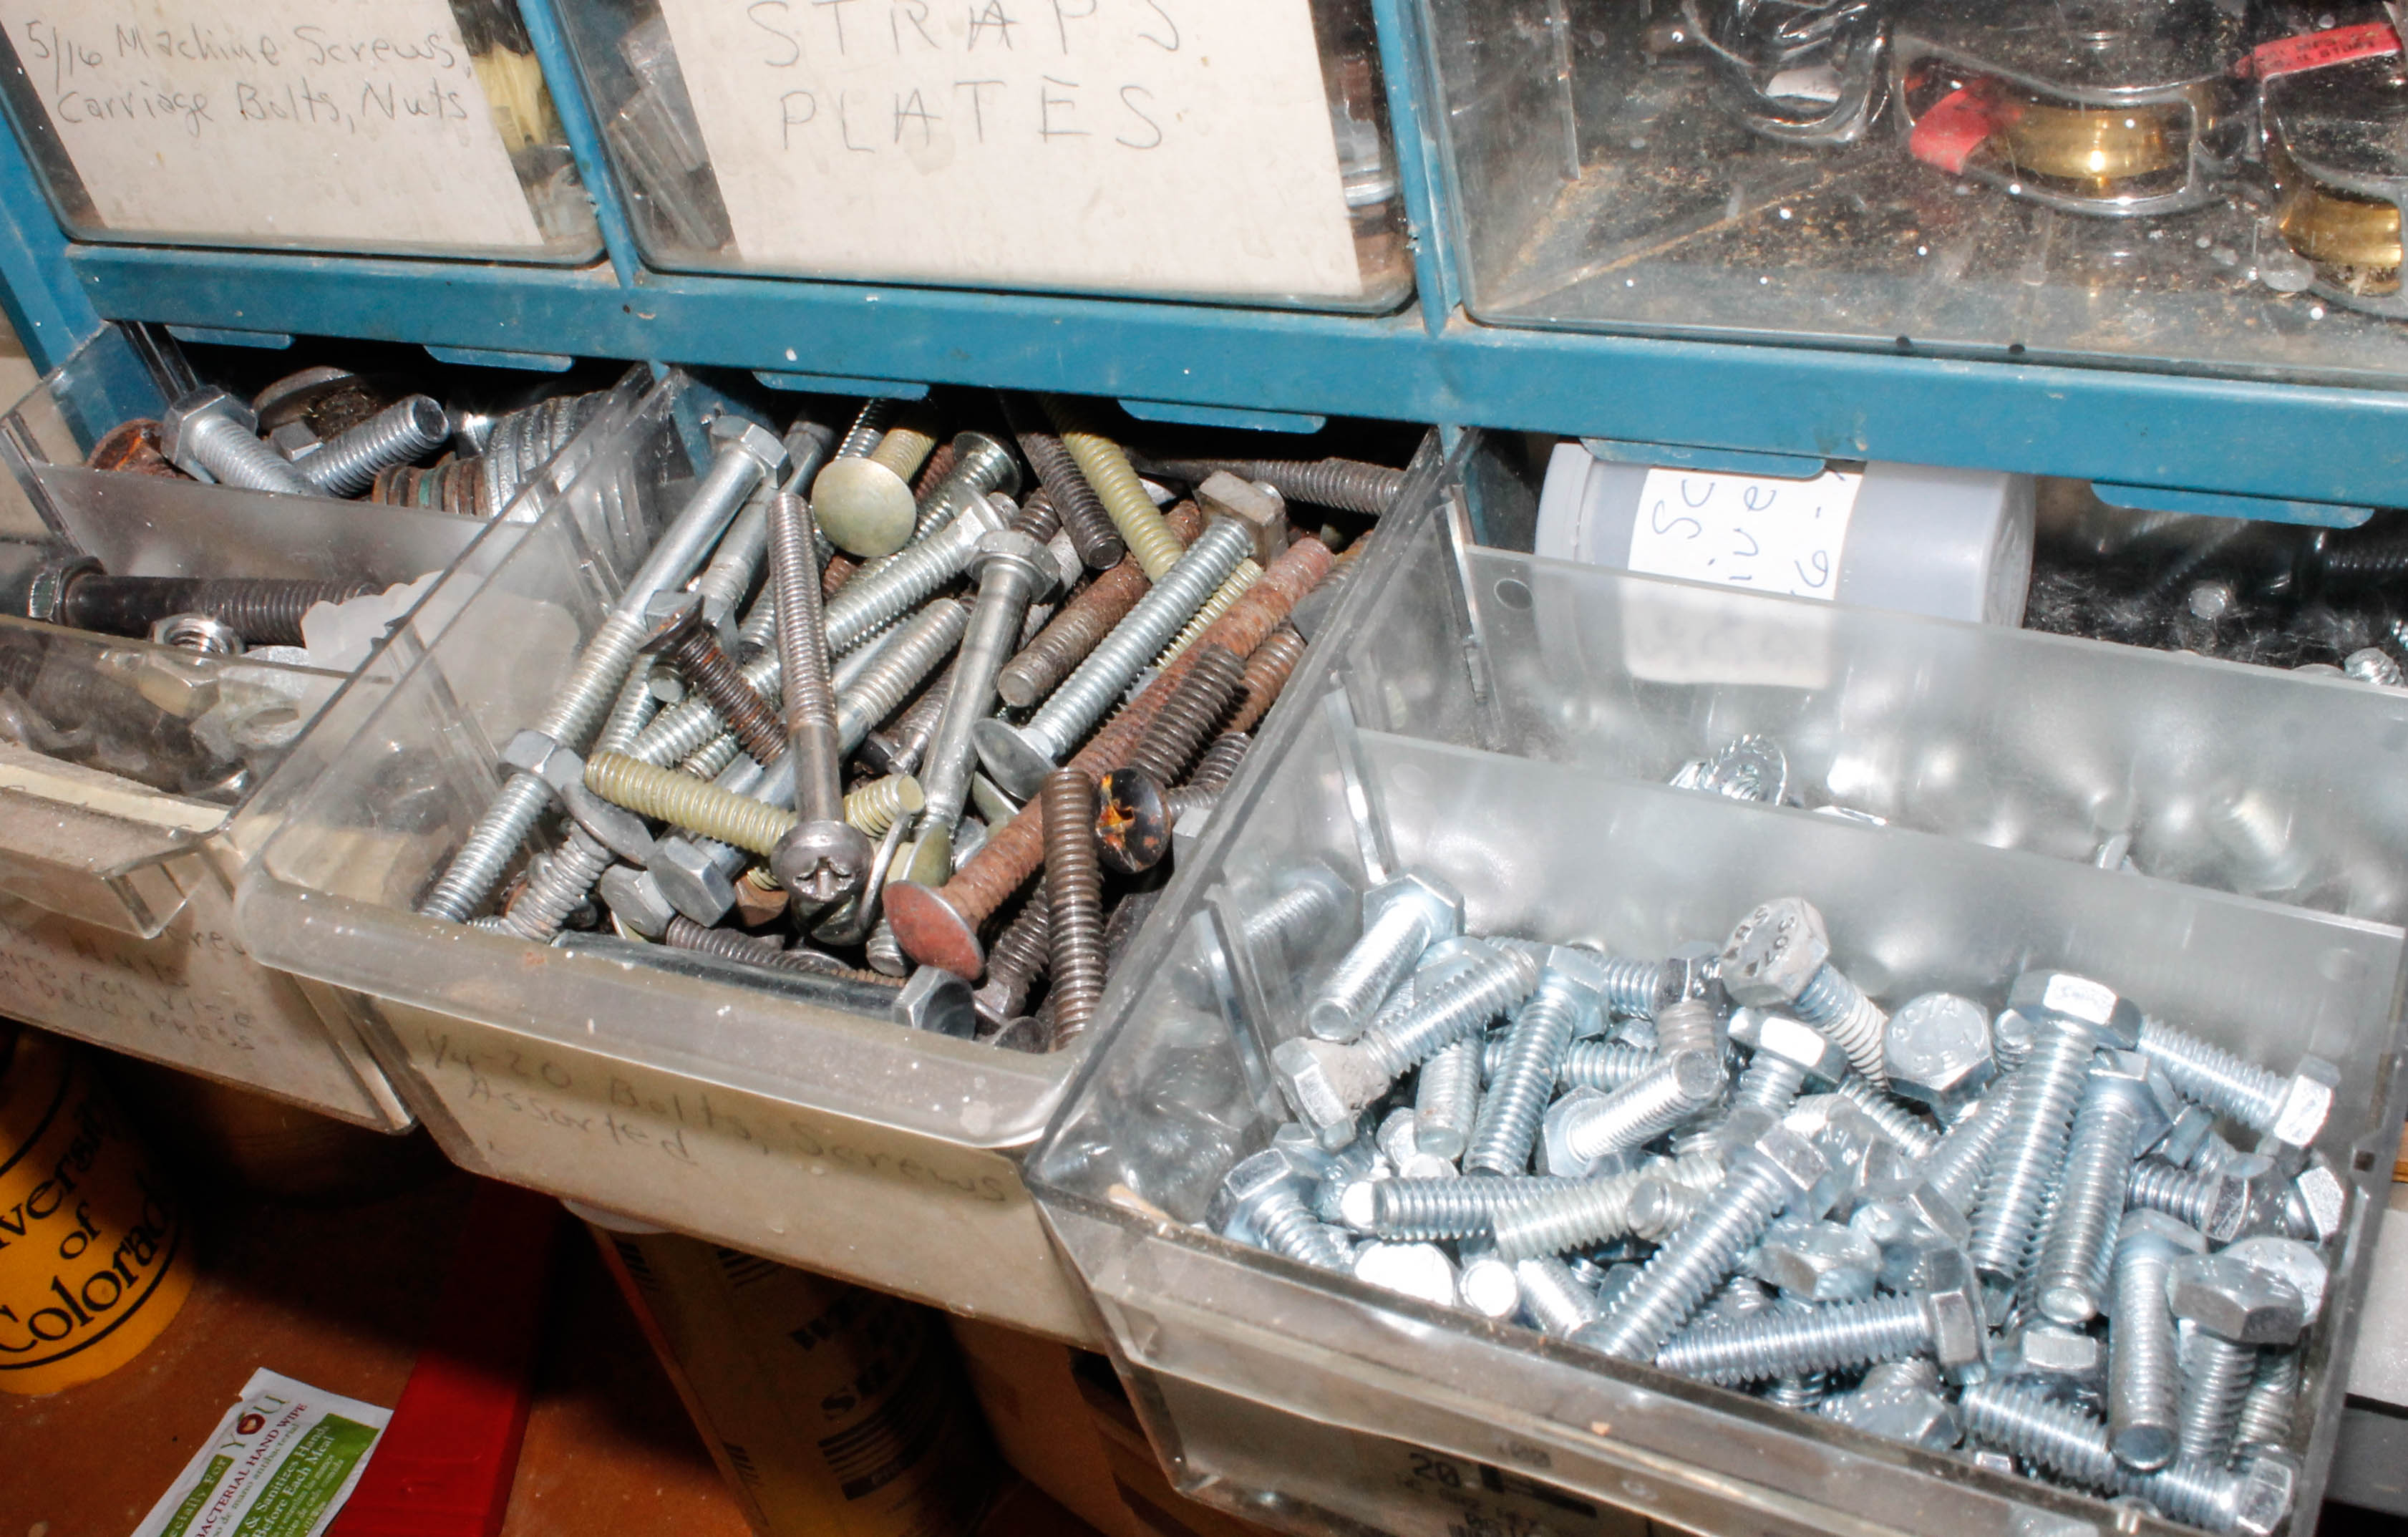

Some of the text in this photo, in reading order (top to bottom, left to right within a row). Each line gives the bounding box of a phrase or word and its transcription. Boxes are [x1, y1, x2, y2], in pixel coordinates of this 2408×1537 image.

[25, 19, 104, 96] 5/16
[115, 21, 281, 67] Machine
[746, 0, 1180, 67] STRAPS
[57, 75, 469, 138] Carriage Bolts, Nuts
[778, 74, 1162, 153] PLATES
[467, 1075, 701, 1168] Assorted
[790, 1120, 1006, 1203] Screws
[58, 1198, 101, 1261] of
[246, 1429, 280, 1467] HAND
[276, 1402, 308, 1428] WIPE
[256, 1460, 299, 1512] Sanitizes
[293, 1425, 331, 1458] Hands
[282, 1466, 312, 1497] Each
[304, 1435, 336, 1466] Meal
